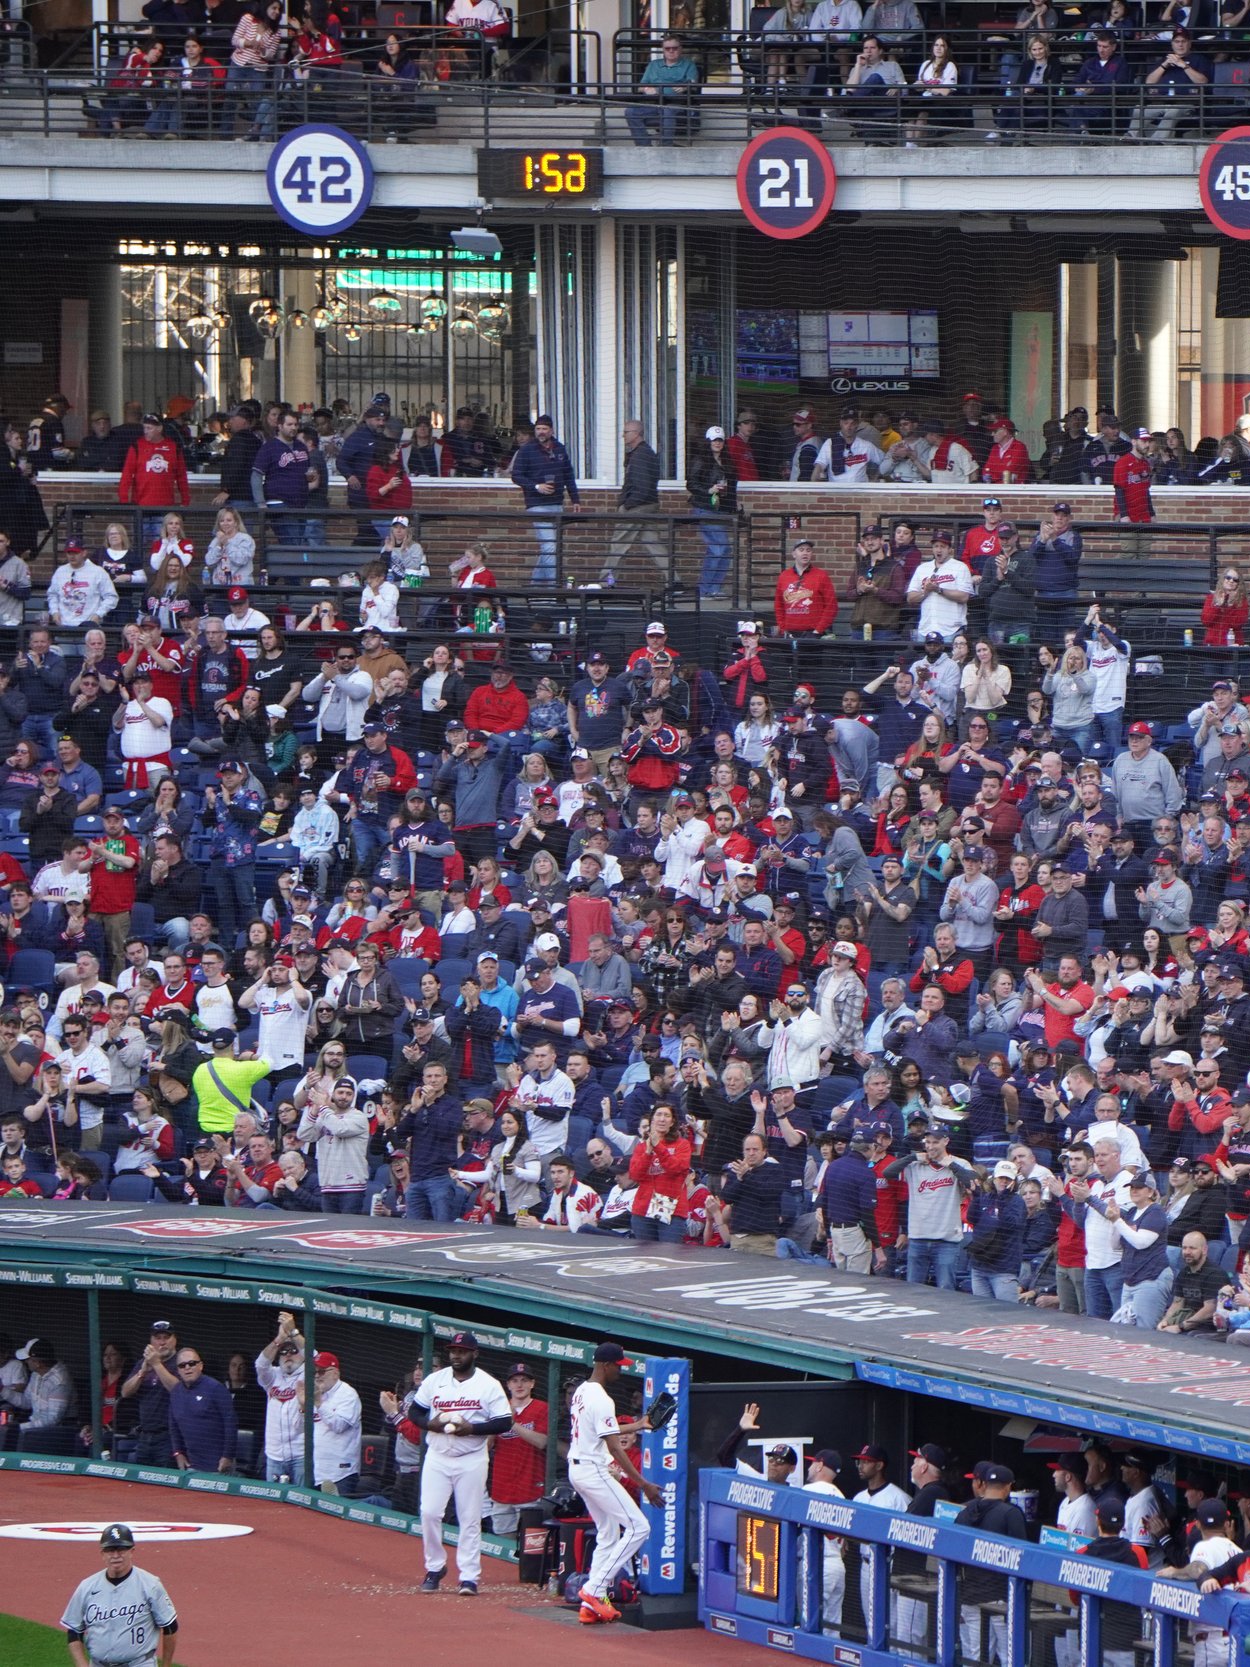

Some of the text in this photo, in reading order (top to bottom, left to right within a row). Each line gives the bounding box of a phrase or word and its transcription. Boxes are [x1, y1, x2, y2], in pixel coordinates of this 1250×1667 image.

[282, 156, 352, 204] 42
[759, 158, 813, 208] 21
[852, 381, 910, 391] LEXUS
[917, 1176, 954, 1193] Indians
[432, 1396, 483, 1412] Guardians
[661, 1482, 676, 1558] Rewards
[728, 1480, 1201, 1616] PROGRESSIVE PROGRESSIVE PROGRESSIVE PROGRESSIVE PROGRESSIVE PROGRESSIVE
[86, 1602, 145, 1625] Chicago
[130, 1627, 145, 1645] 18
